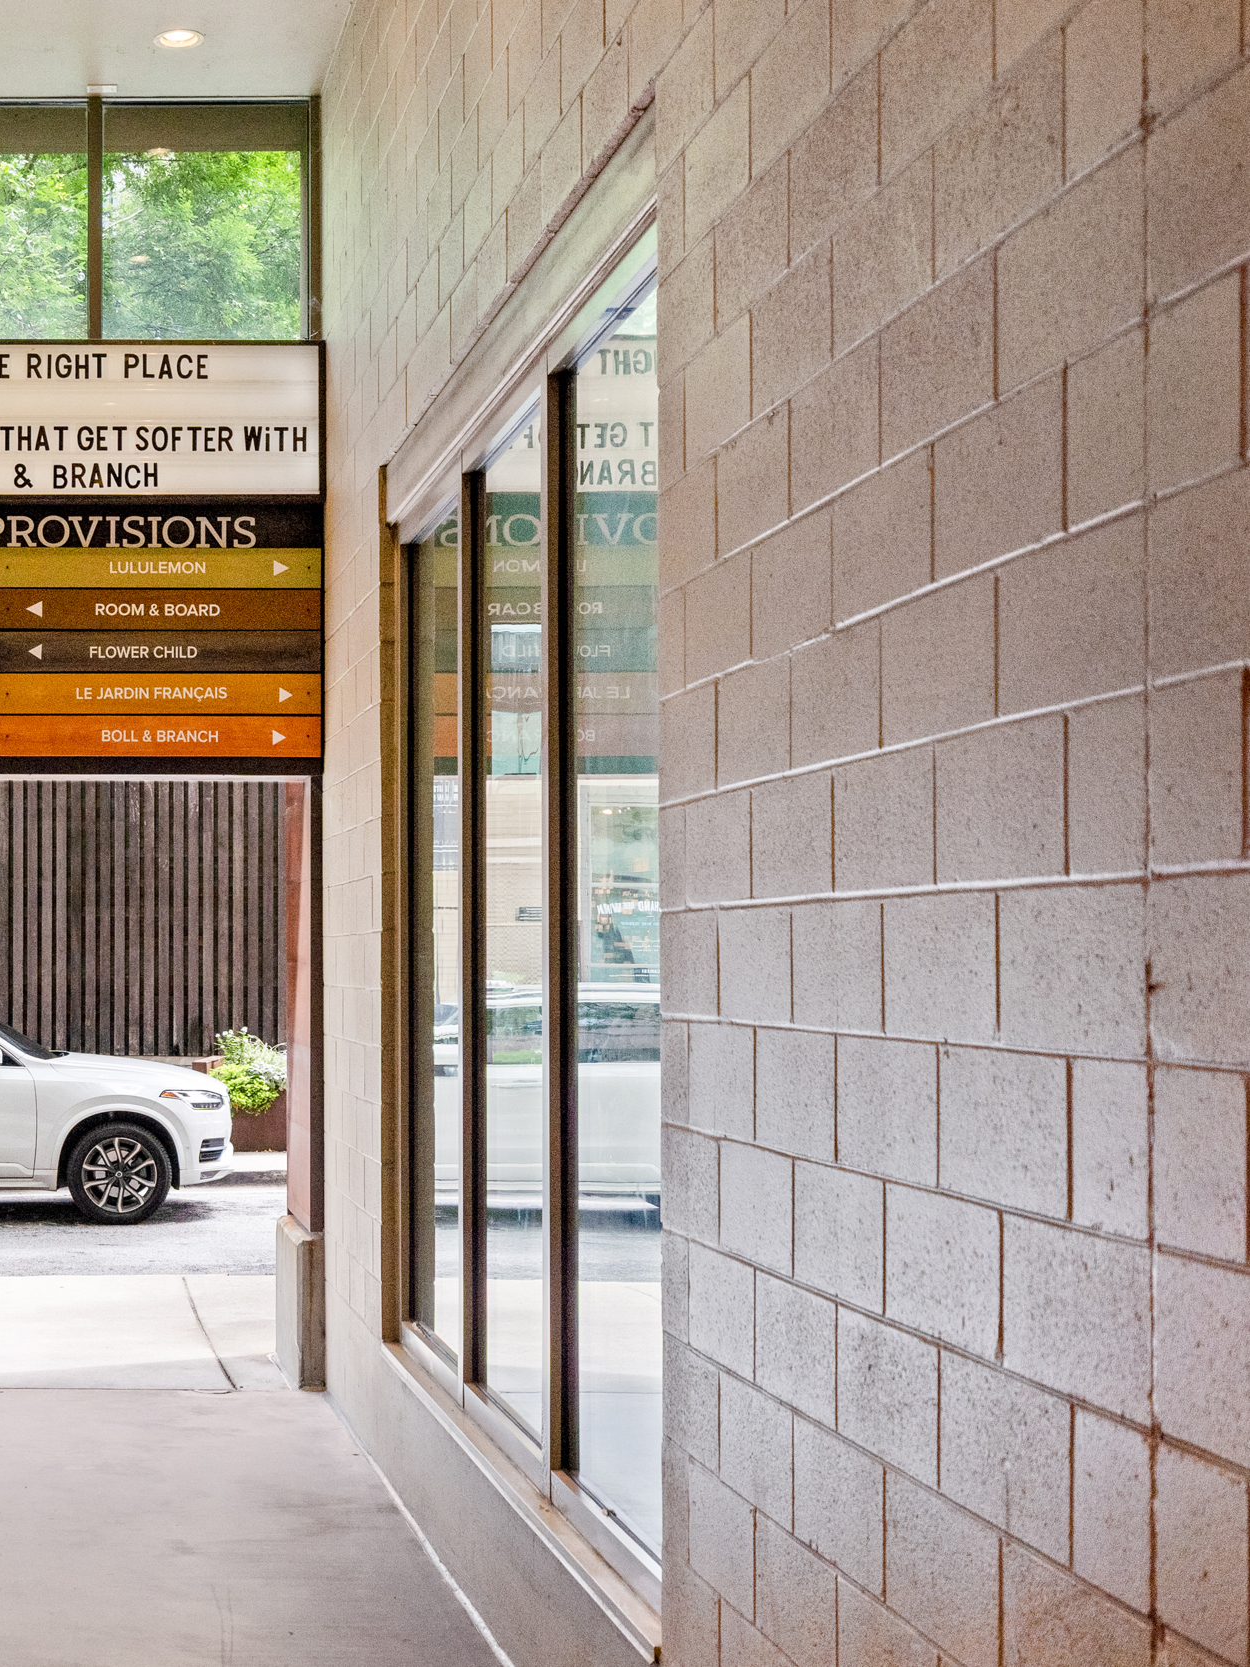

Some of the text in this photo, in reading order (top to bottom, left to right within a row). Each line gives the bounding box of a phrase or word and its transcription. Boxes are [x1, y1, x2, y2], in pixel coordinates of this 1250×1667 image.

[26, 353, 107, 379] RIGHT
[124, 353, 208, 379] PLACE
[0, 425, 68, 452] THAT
[77, 425, 128, 452] GET
[135, 425, 233, 452] SOFTER
[14, 463, 33, 489] &
[53, 462, 158, 489] BRANCH
[109, 561, 206, 574] LULULEMON
[95, 603, 220, 617] ROOM & BOARD
[89, 646, 198, 659] FLOWER CHILD
[76, 686, 228, 703] LE JARDIN FRANÇAIS
[101, 730, 219, 743] BOLL & BRANCH
